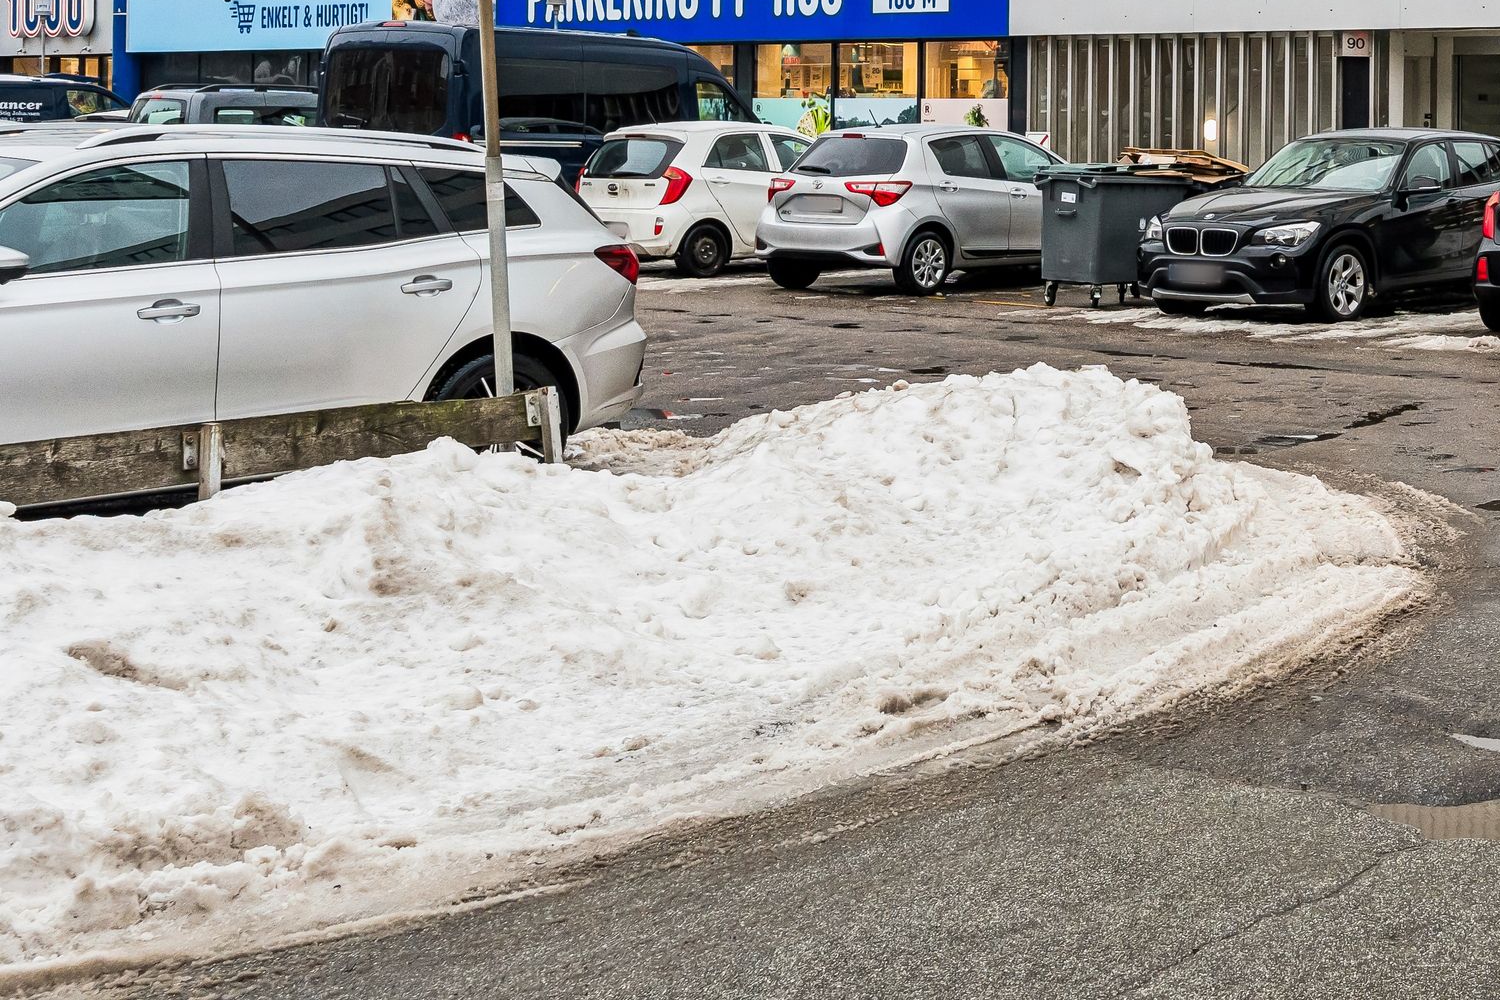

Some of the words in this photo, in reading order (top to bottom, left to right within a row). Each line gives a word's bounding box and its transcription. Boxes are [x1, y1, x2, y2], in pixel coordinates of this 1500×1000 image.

[261, 7, 299, 29] ENKELT
[303, 6, 312, 27] &
[316, 3, 369, 27] HURTIGT!
[1347, 38, 1365, 49] 90
